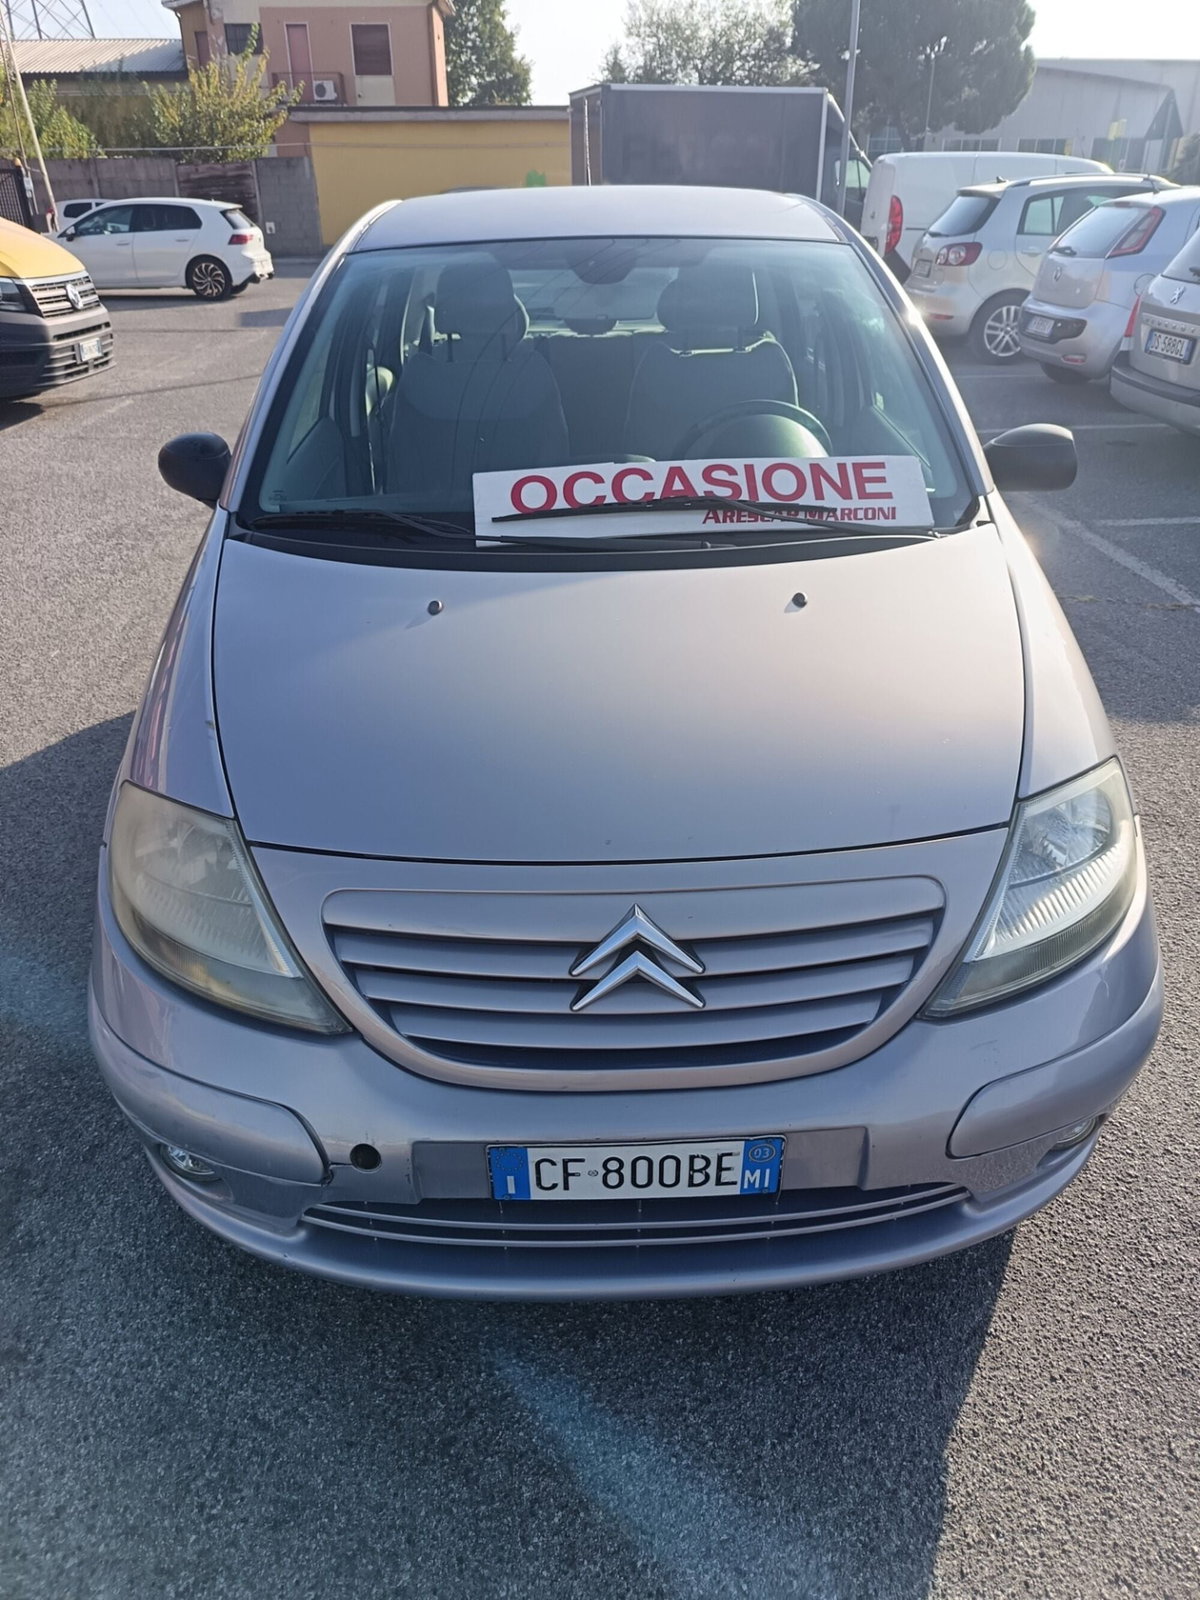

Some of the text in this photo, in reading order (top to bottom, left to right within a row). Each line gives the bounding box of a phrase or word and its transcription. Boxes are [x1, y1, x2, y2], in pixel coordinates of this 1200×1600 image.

[510, 462, 894, 514] OCCASIONE
[702, 508, 799, 524] ARES
[535, 1158, 586, 1191] CF
[602, 1152, 740, 1190] 800BE
[743, 1168, 770, 1189] MI
